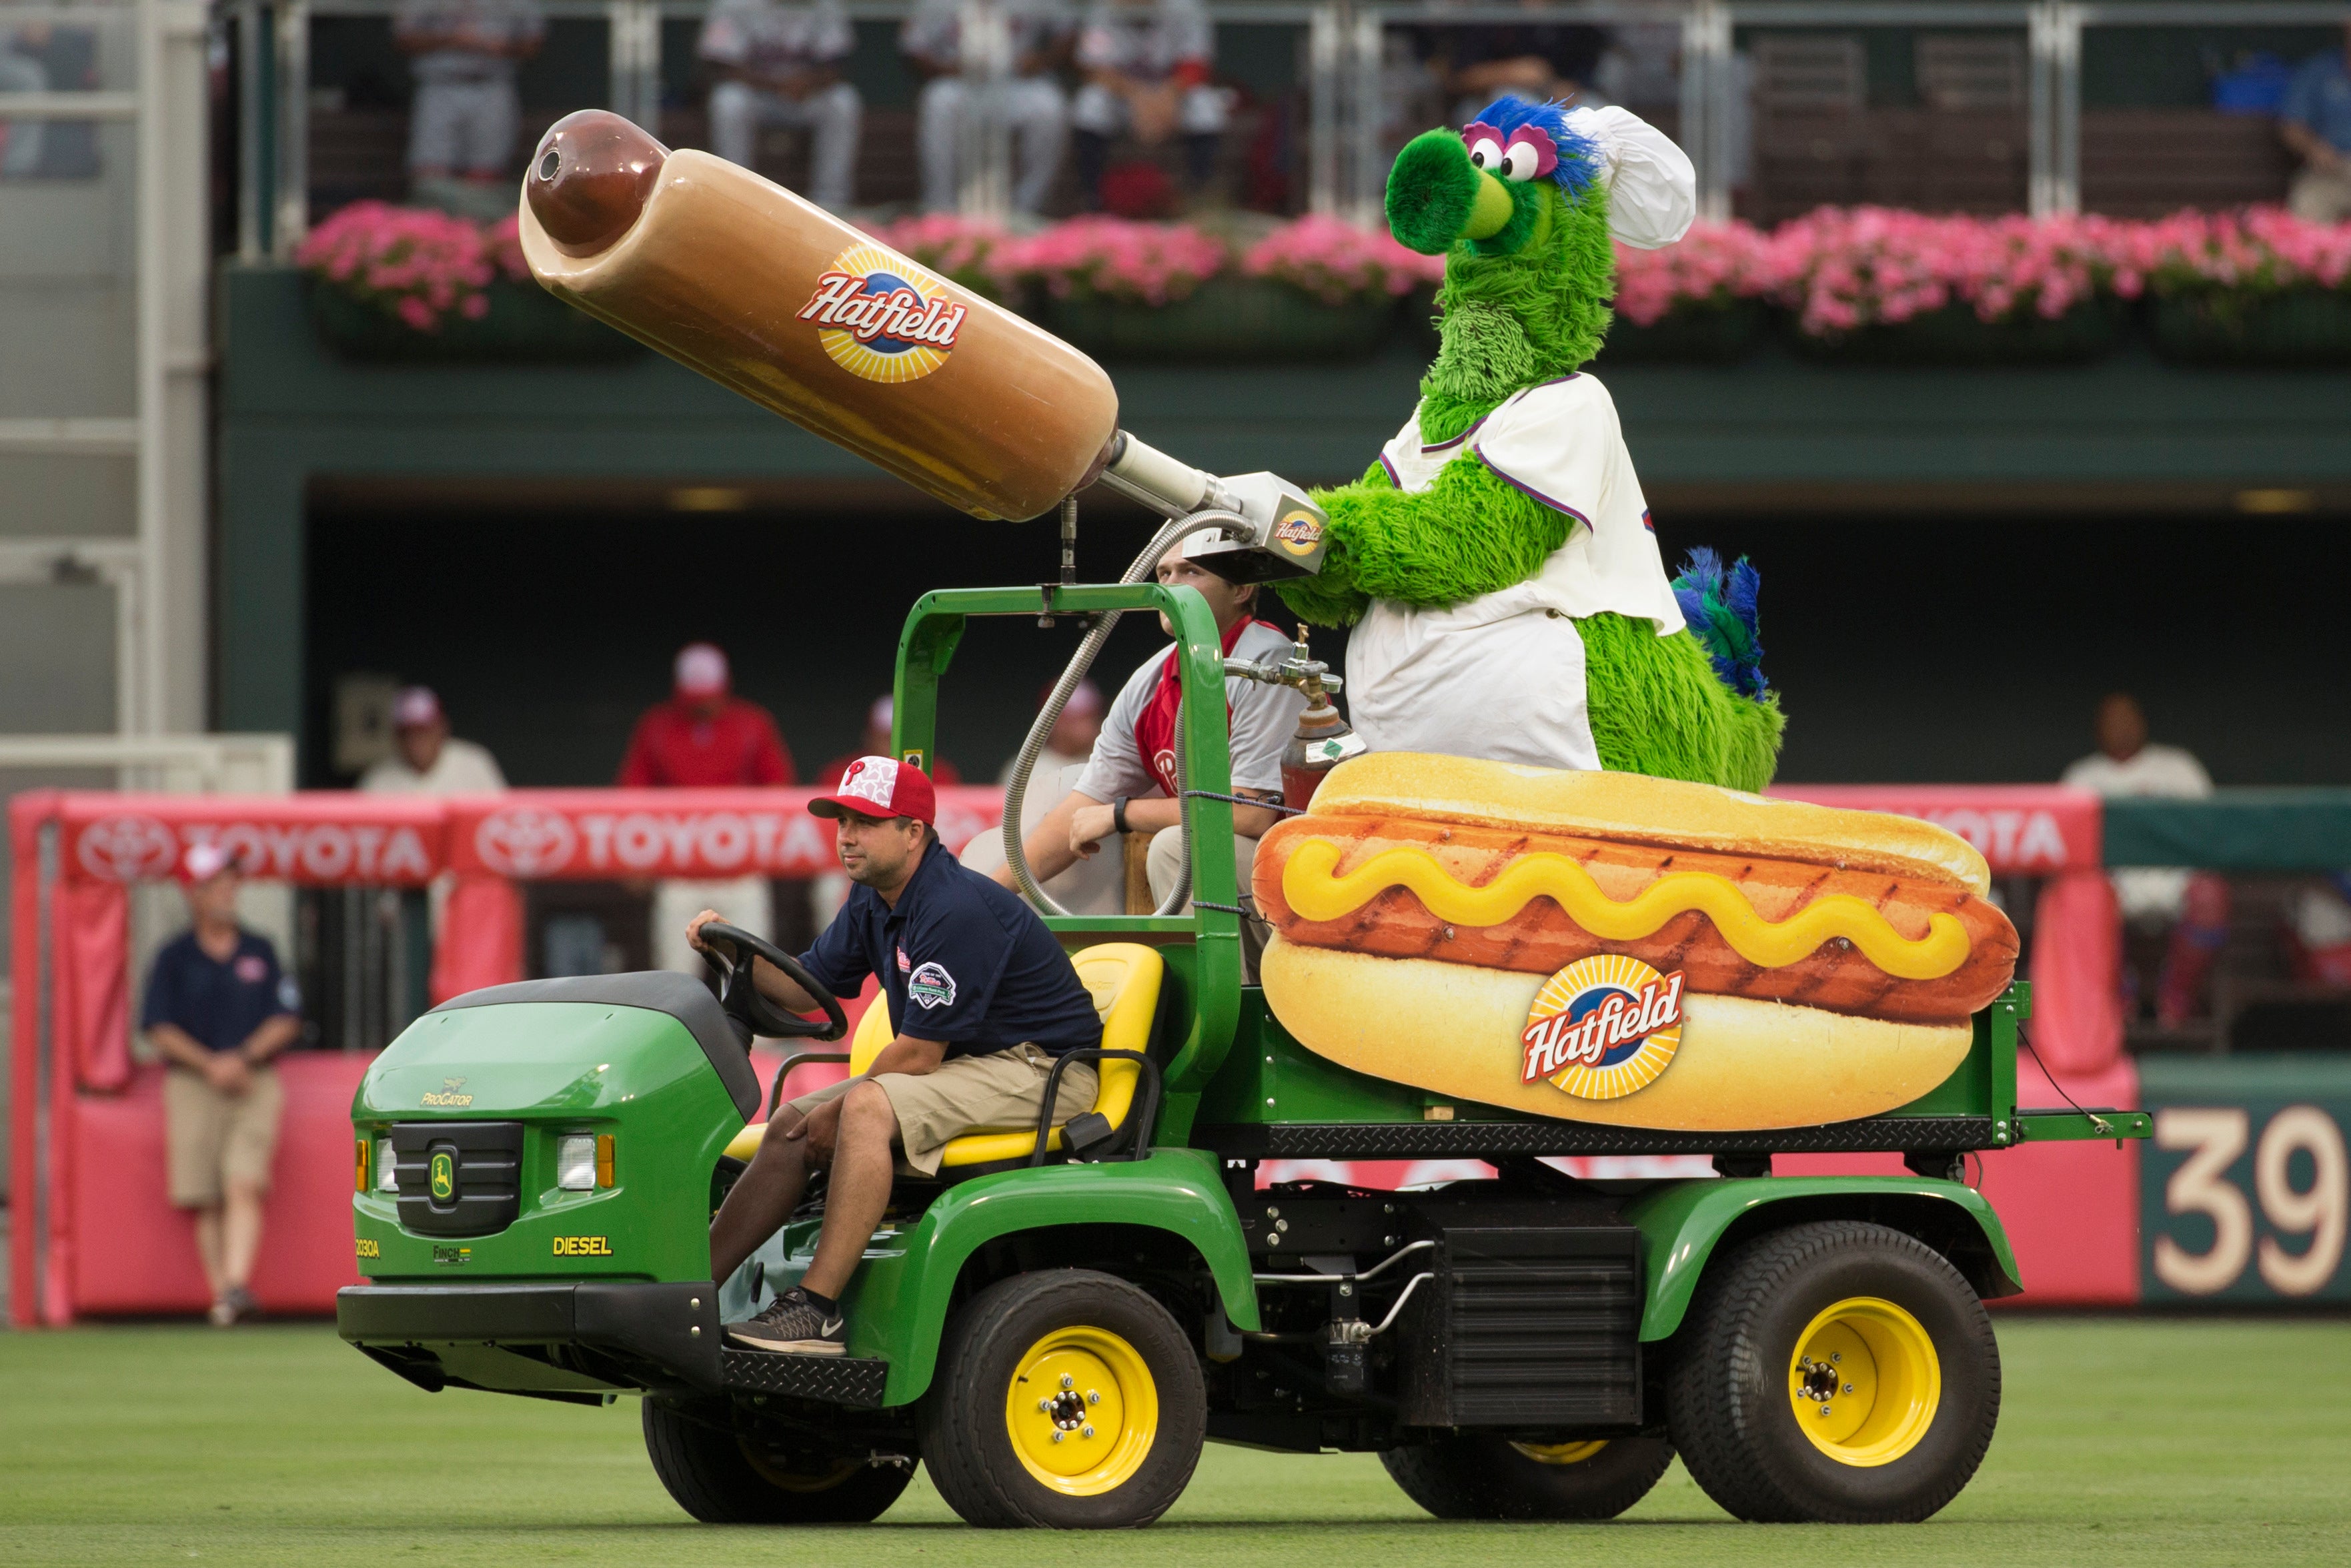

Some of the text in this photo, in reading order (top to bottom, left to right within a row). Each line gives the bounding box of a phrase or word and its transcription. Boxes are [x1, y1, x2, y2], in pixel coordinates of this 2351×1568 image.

[796, 270, 968, 351] Hatfield
[1275, 521, 1324, 543] Hatfield
[845, 761, 865, 786] P
[584, 813, 827, 867] TOYOTA
[1521, 970, 1685, 1085] Hatfield
[2153, 1105, 2350, 1297] 39
[433, 1245, 460, 1259] FINCH
[553, 1236, 613, 1257] DIESEL
